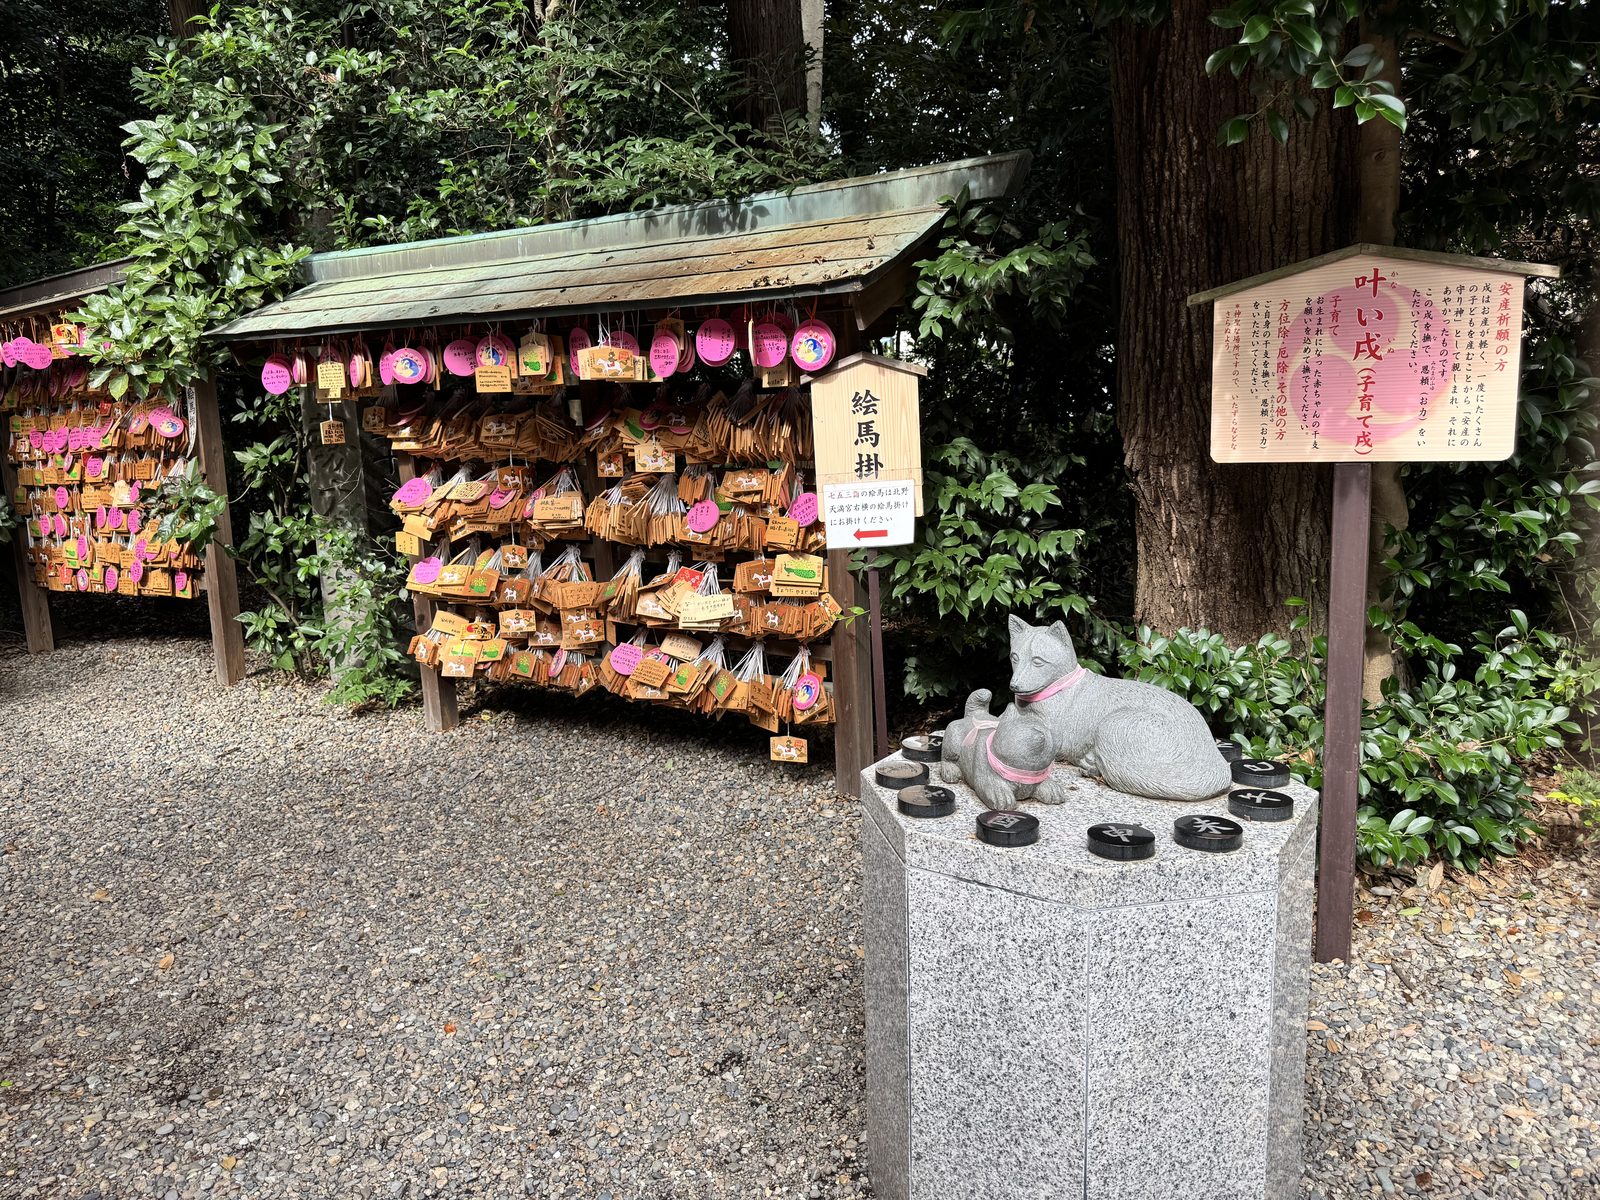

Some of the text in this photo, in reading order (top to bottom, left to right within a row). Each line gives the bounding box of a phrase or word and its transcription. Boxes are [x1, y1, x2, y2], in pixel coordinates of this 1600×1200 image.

[1328, 295, 1342, 337] 子育て
[1390, 270, 1399, 289] かな
[1250, 300, 1261, 400] をいただいてください。
[1386, 336, 1396, 355] いぬ
[1408, 288, 1422, 375] ただいてください。
[1438, 286, 1452, 383] あやかったものです。
[1494, 281, 1513, 373] 安産祈願の方
[1311, 296, 1325, 450] お生まれになった赤ちゃんの干支
[851, 389, 884, 480] 絵馬掛
[830, 516, 893, 526] にお掛けください
